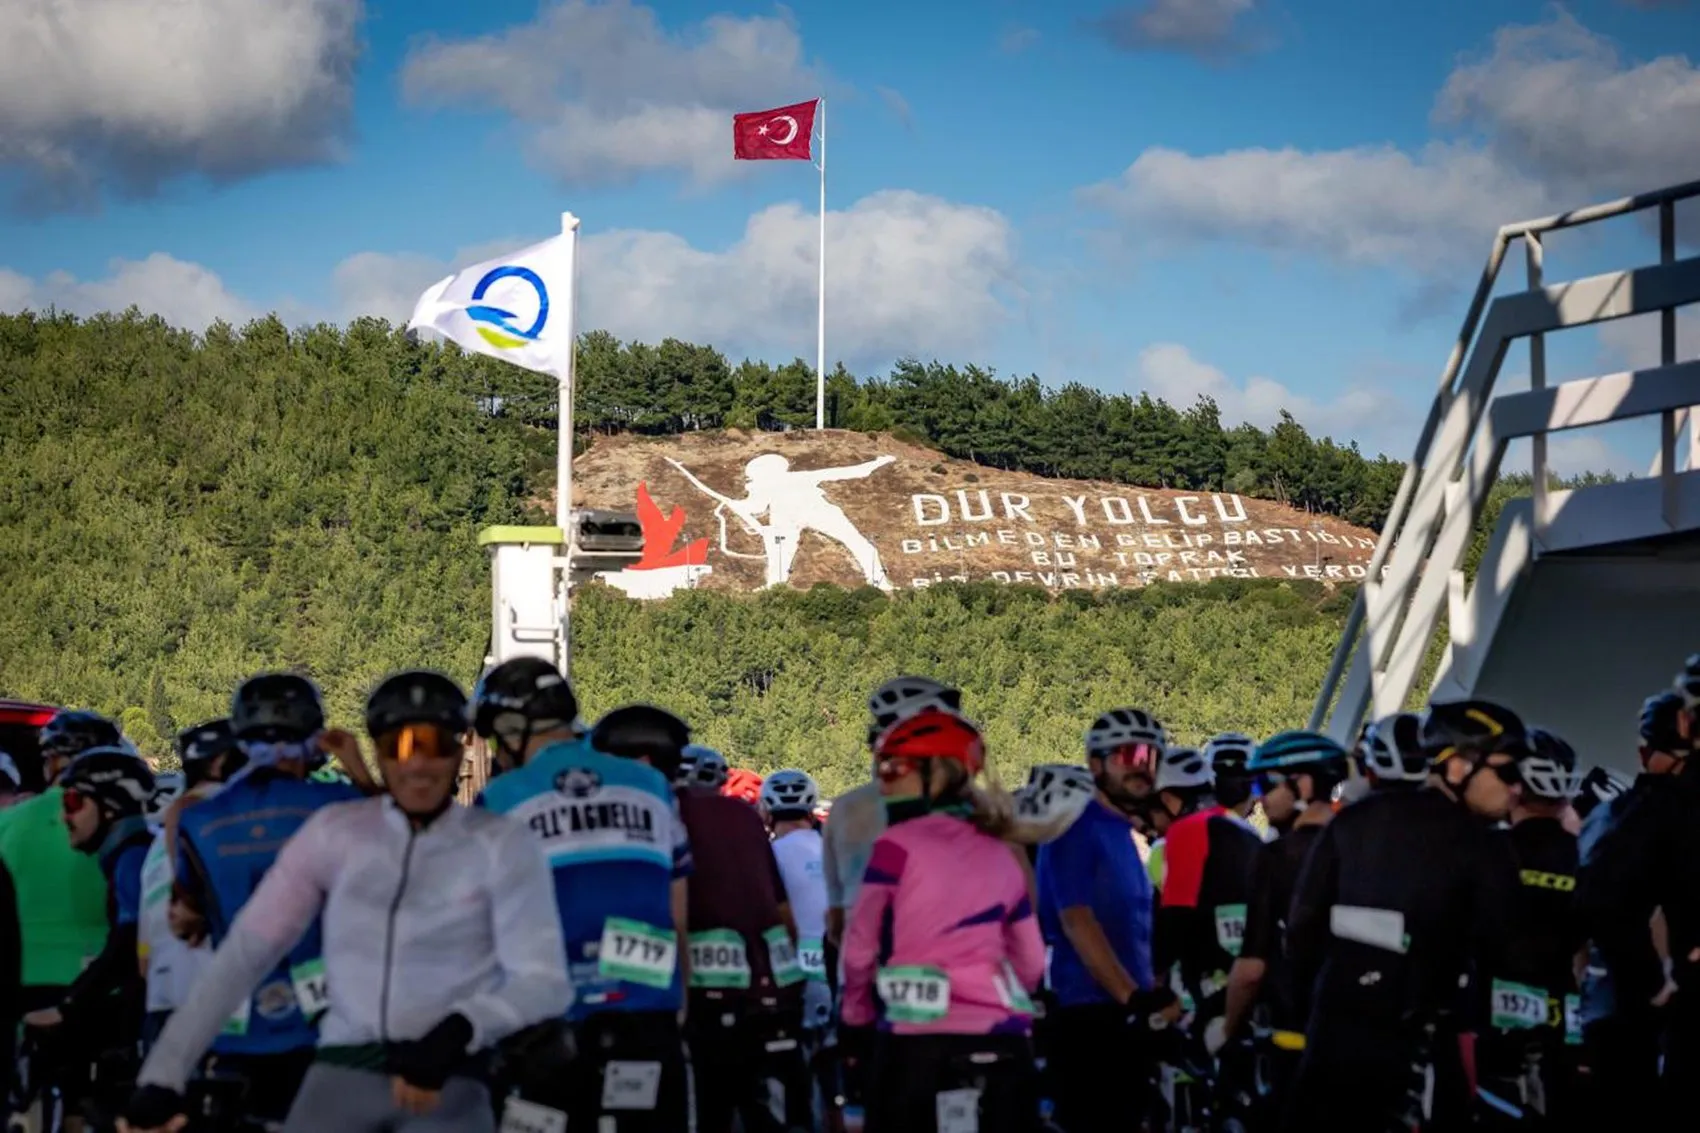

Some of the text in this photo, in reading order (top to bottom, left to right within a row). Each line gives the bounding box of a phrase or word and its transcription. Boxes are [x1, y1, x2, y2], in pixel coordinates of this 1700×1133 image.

[911, 489, 1248, 526] DUR YOLCU
[1031, 549, 1247, 567] BU TOPRAK
[613, 933, 666, 964] 1719
[800, 950, 824, 967] 16
[888, 979, 940, 1003] 1718
